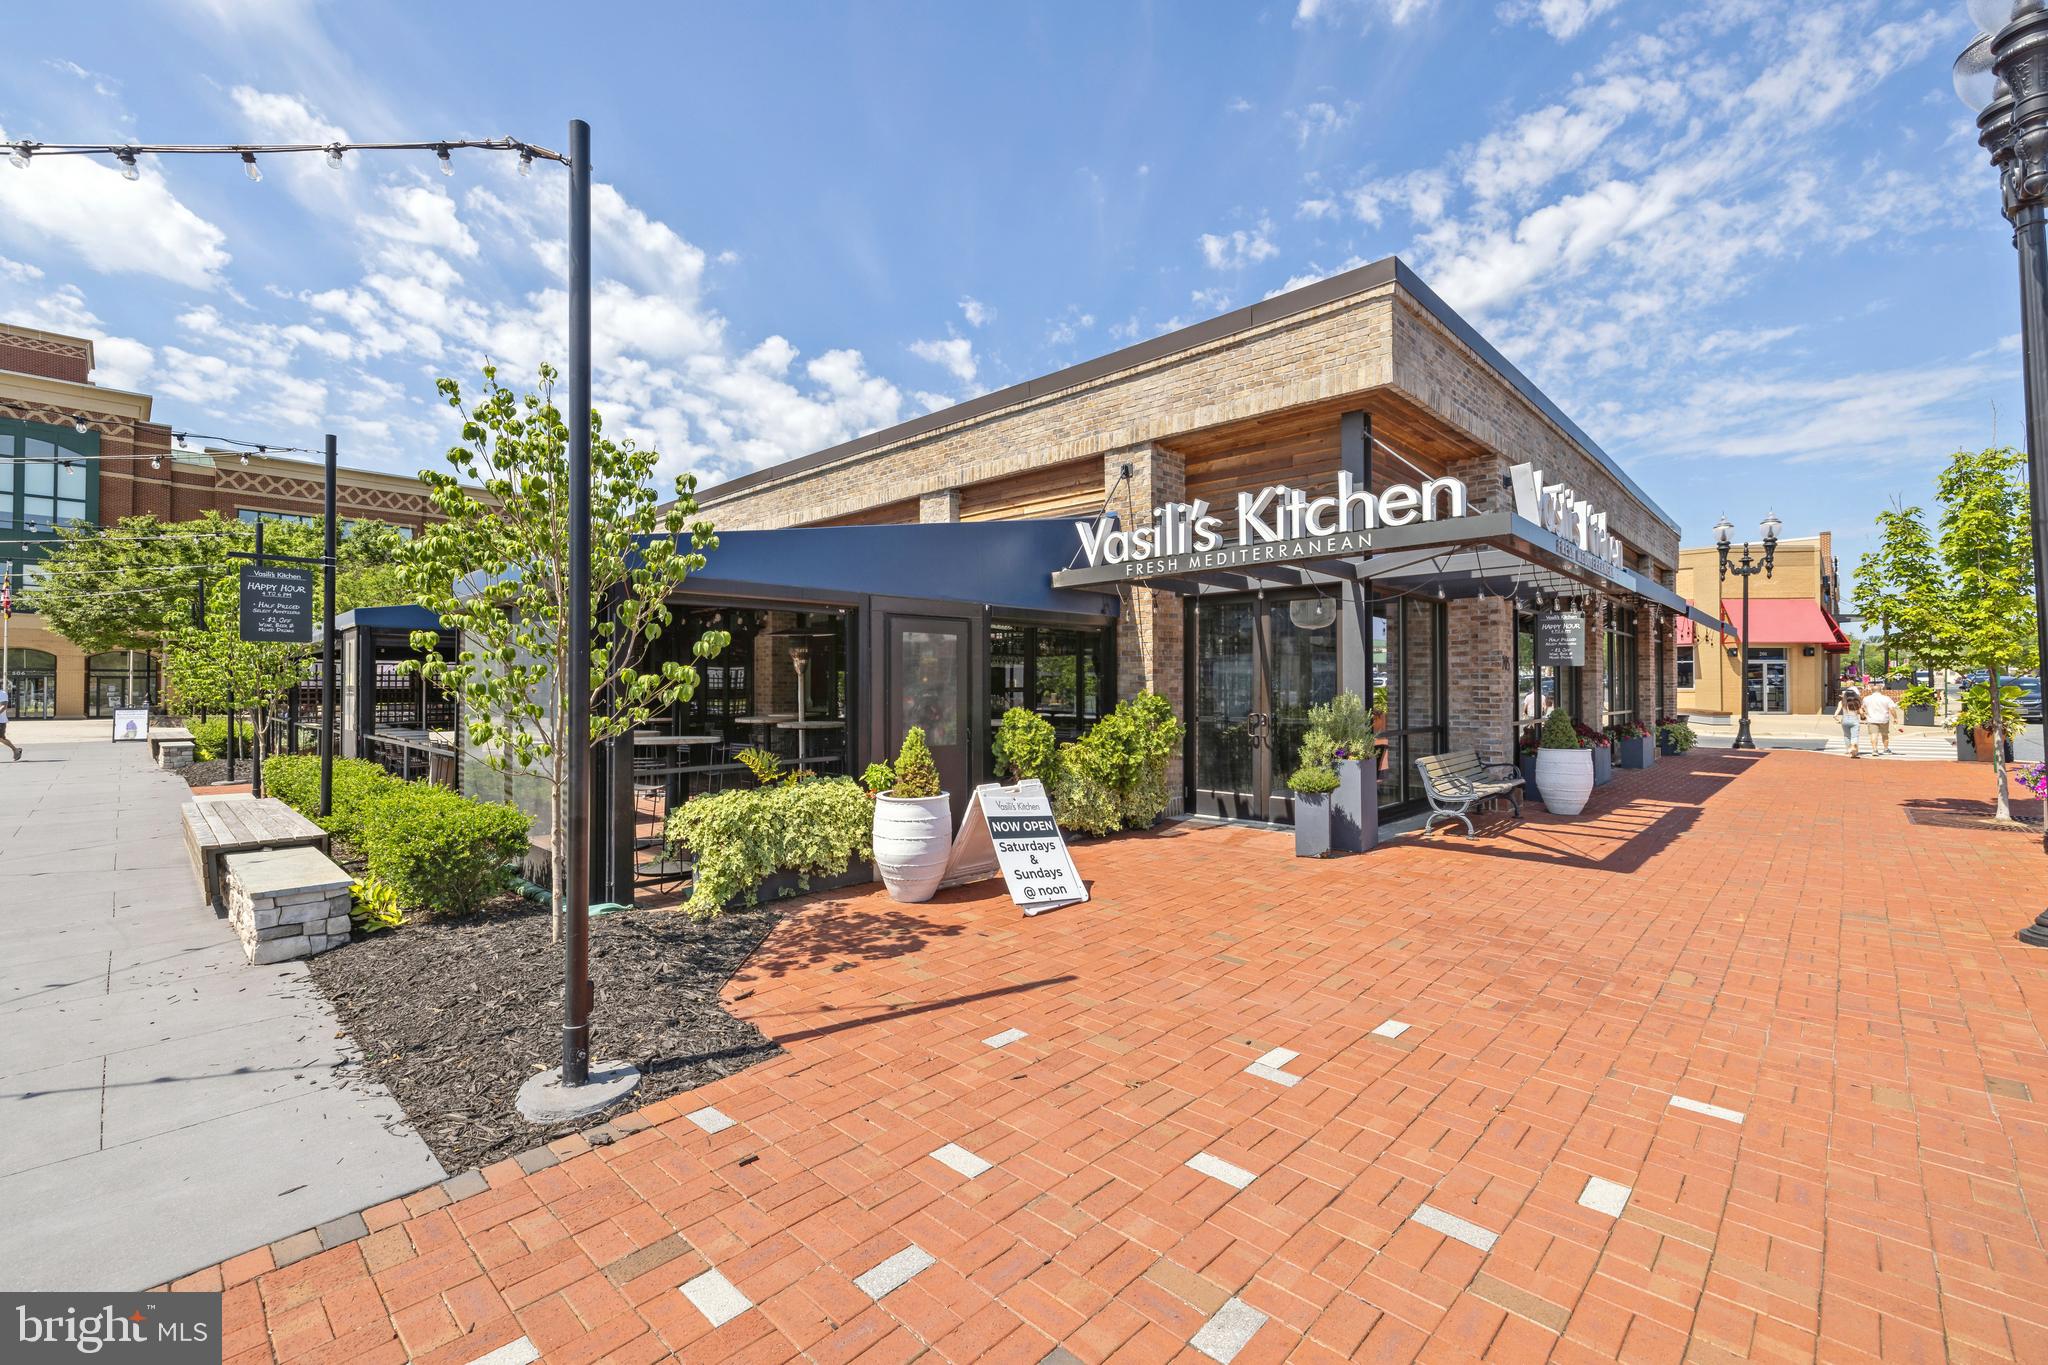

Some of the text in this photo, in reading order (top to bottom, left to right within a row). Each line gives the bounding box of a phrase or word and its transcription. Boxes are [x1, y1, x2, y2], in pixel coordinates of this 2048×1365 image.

[1074, 470, 1469, 568] Vasili's Kitchen
[1126, 533, 1372, 577] FRESH MEDITERRANEAN
[247, 582, 306, 593] HAPPY HOUR
[995, 800, 1041, 811] Vasili's Kitchen
[991, 820, 1054, 832] NOW OPEN
[999, 840, 1056, 853] Saturdays
[1029, 854, 1039, 865] &
[1014, 867, 1063, 880] Sundays
[1023, 885, 1068, 899] @ noon
